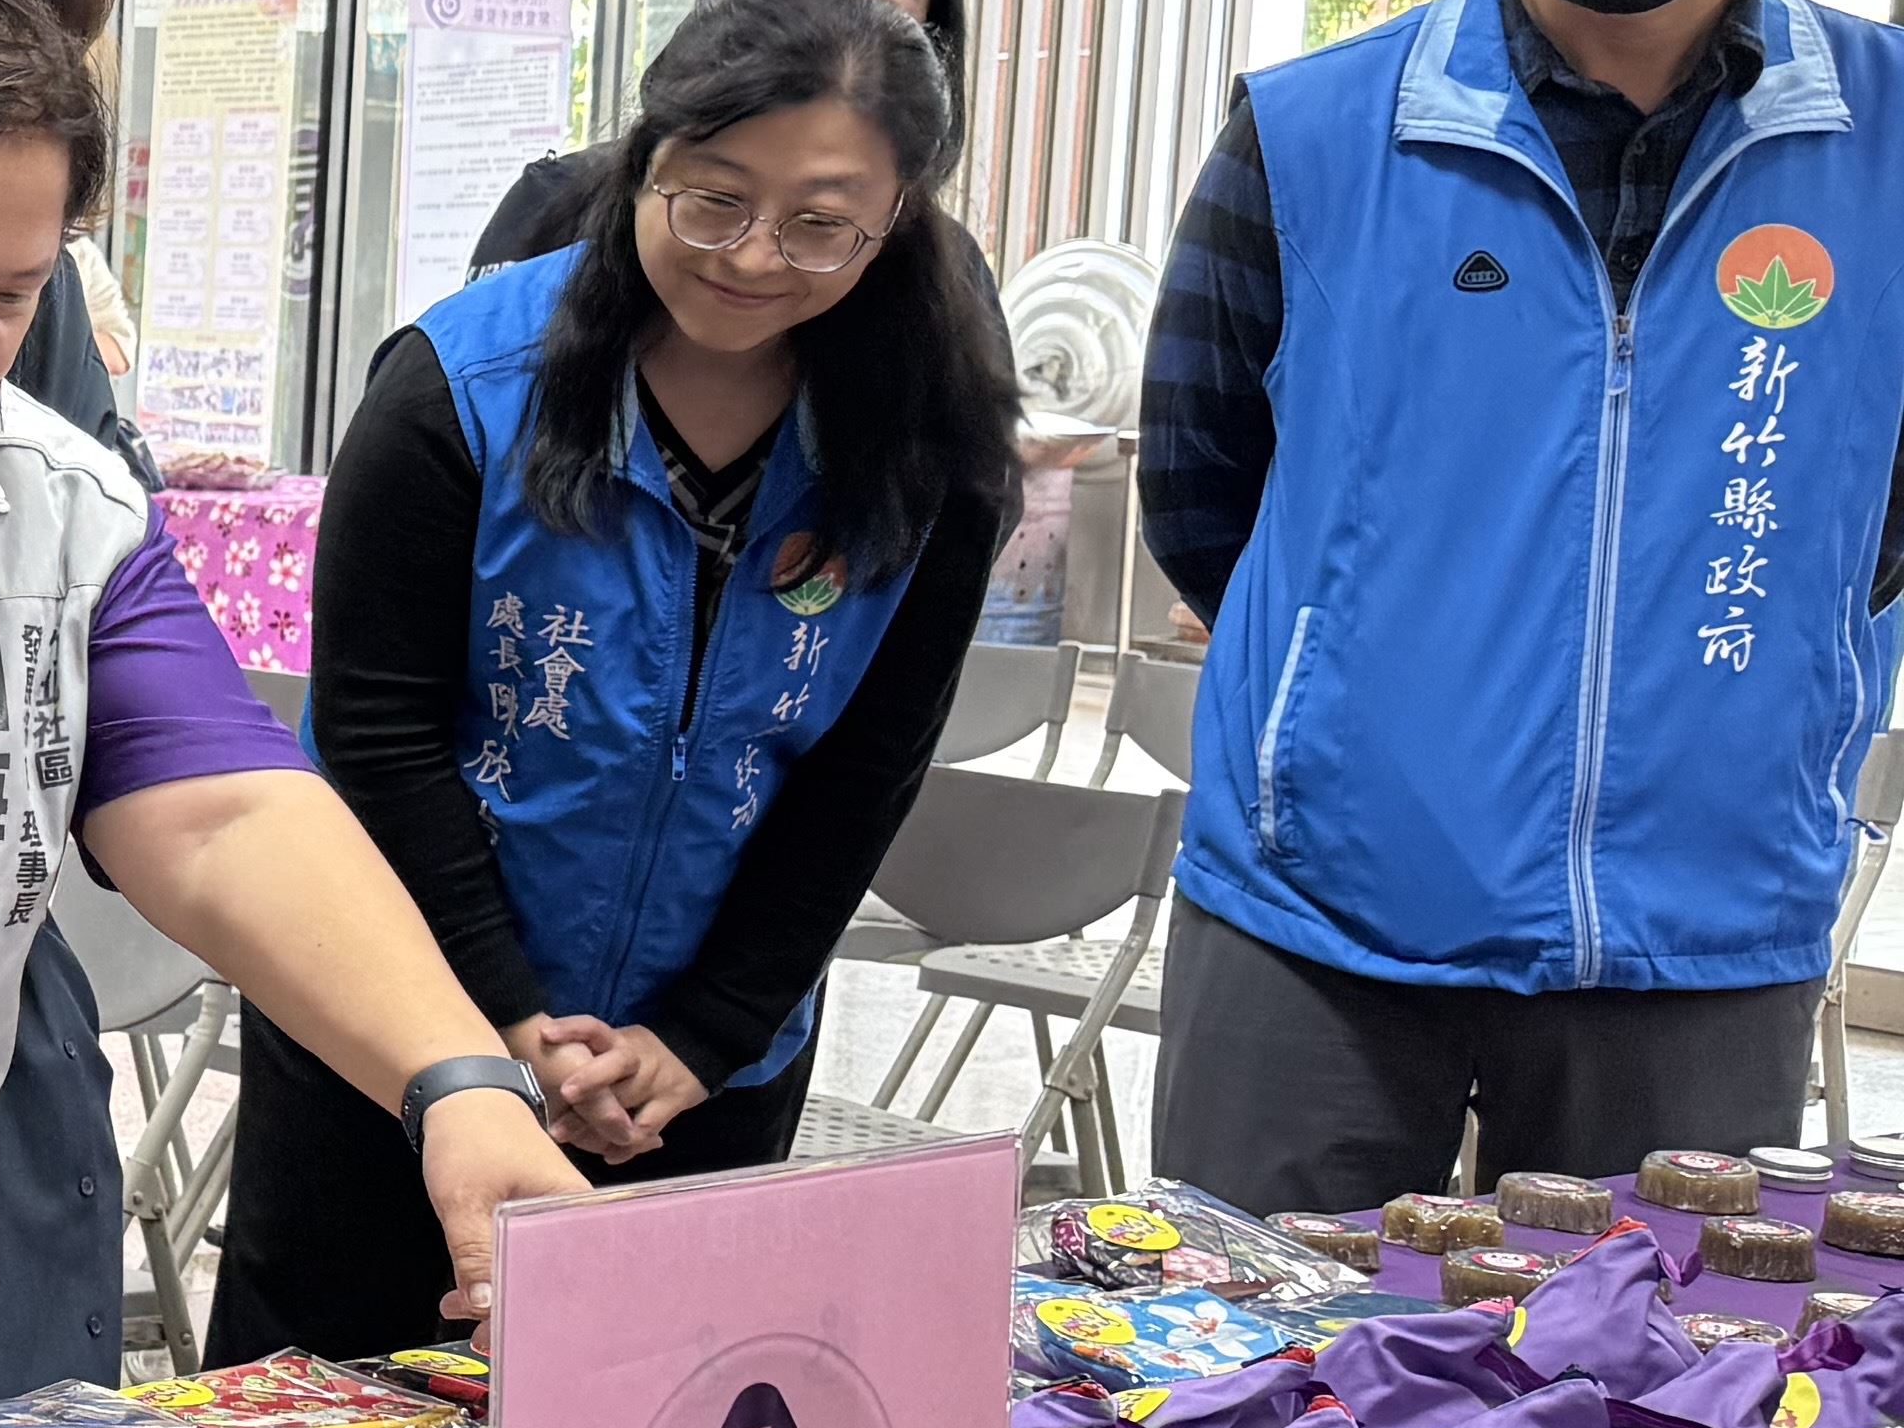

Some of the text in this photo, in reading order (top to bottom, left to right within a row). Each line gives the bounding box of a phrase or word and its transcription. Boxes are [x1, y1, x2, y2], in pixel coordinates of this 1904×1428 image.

[1697, 335, 1799, 673] 新竹縣政府
[522, 604, 594, 740] 社會處
